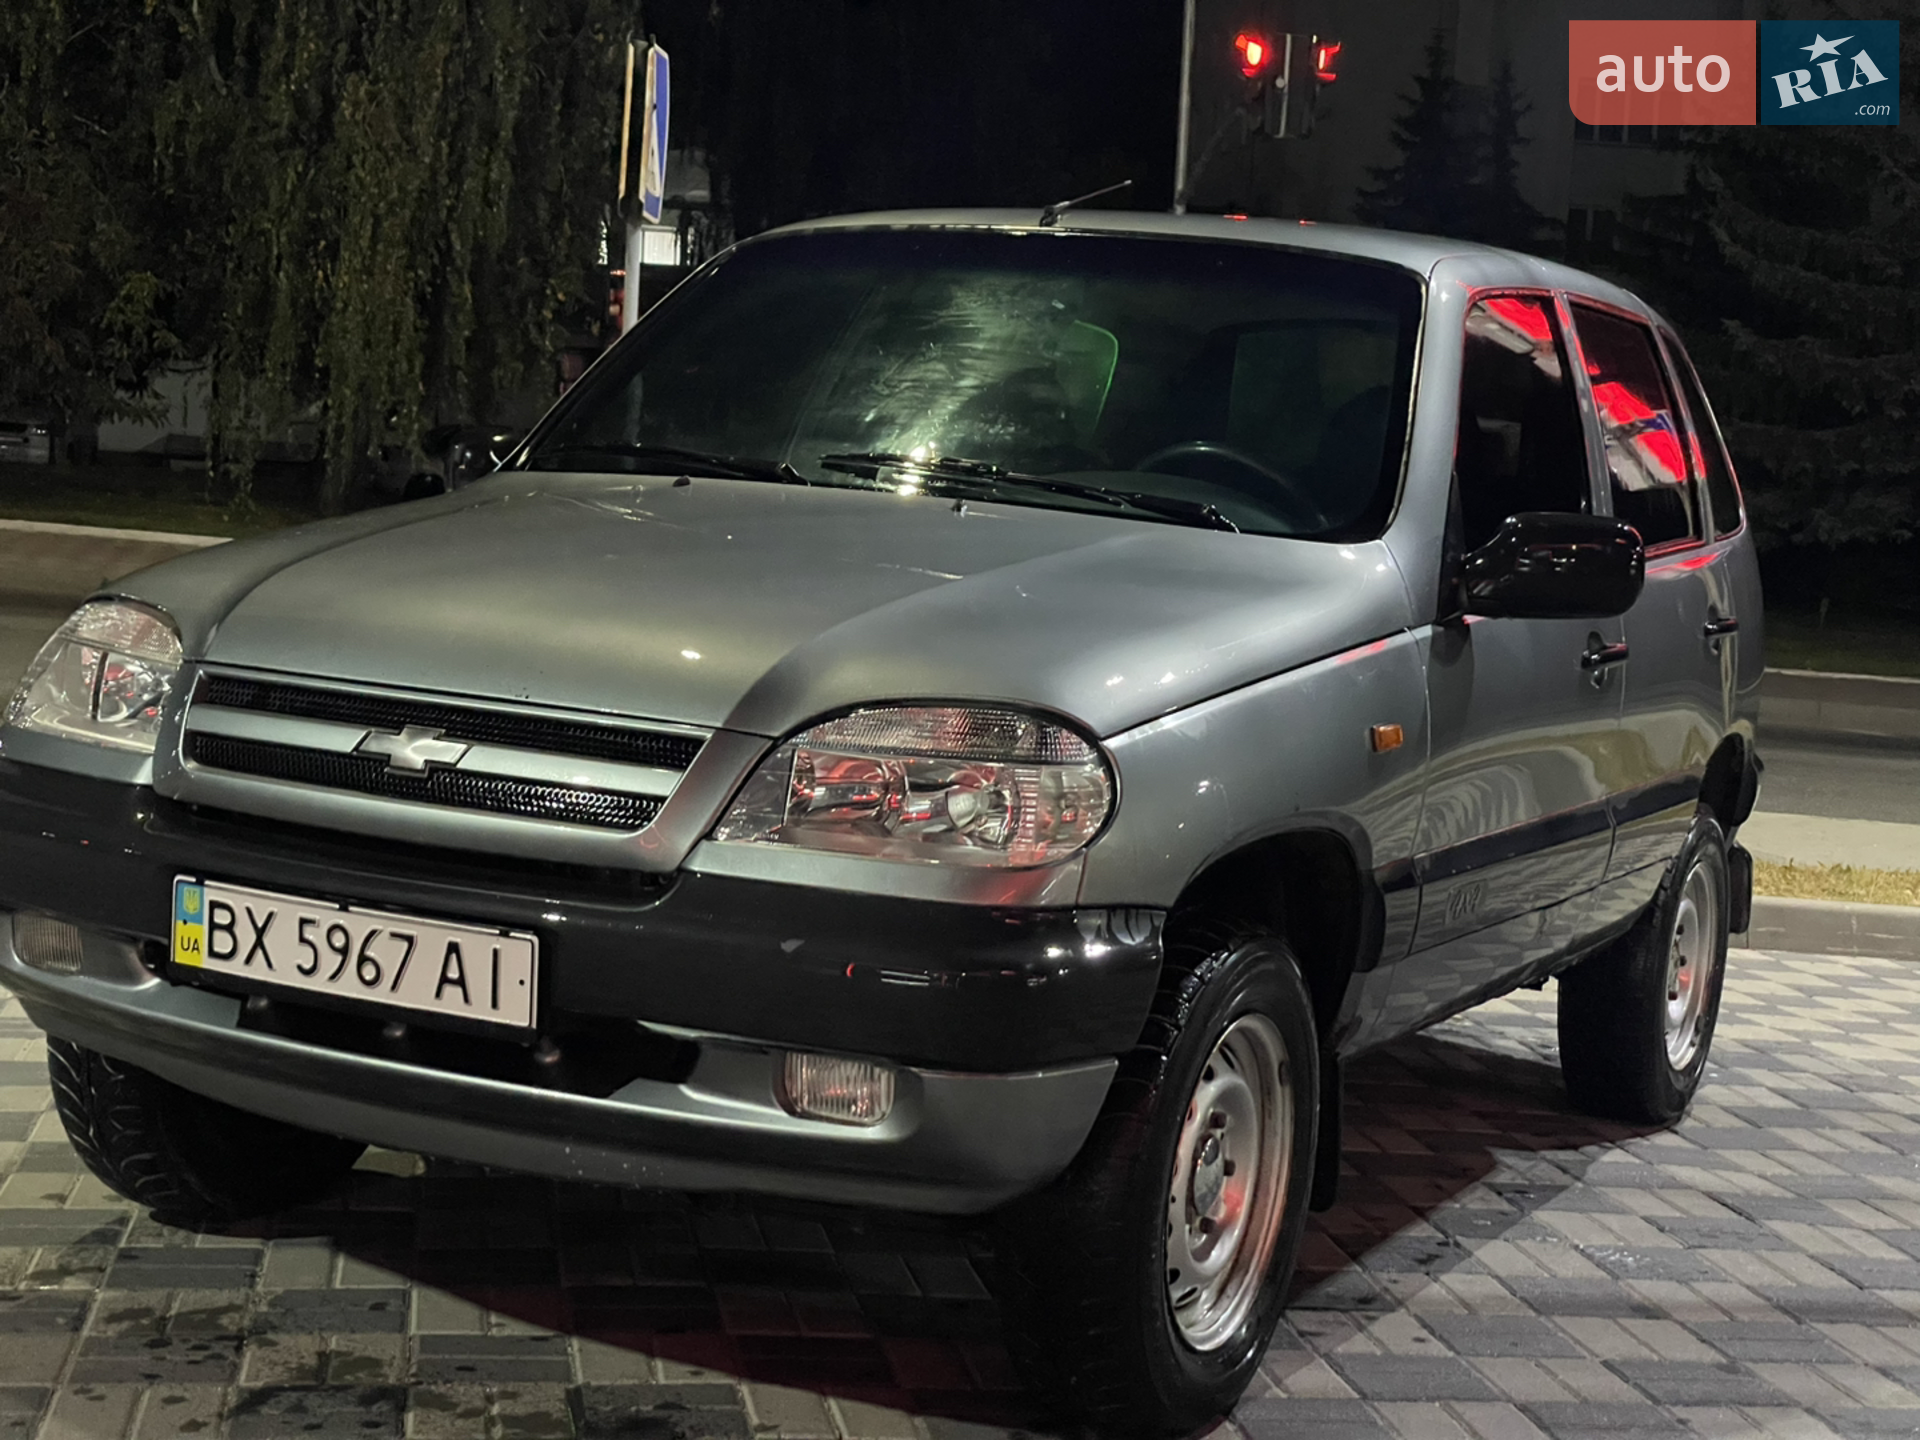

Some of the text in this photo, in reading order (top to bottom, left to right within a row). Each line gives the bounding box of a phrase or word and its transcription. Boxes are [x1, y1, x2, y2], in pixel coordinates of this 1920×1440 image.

[180, 936, 200, 955] UA
[207, 899, 502, 1011] BX 5967 AI
